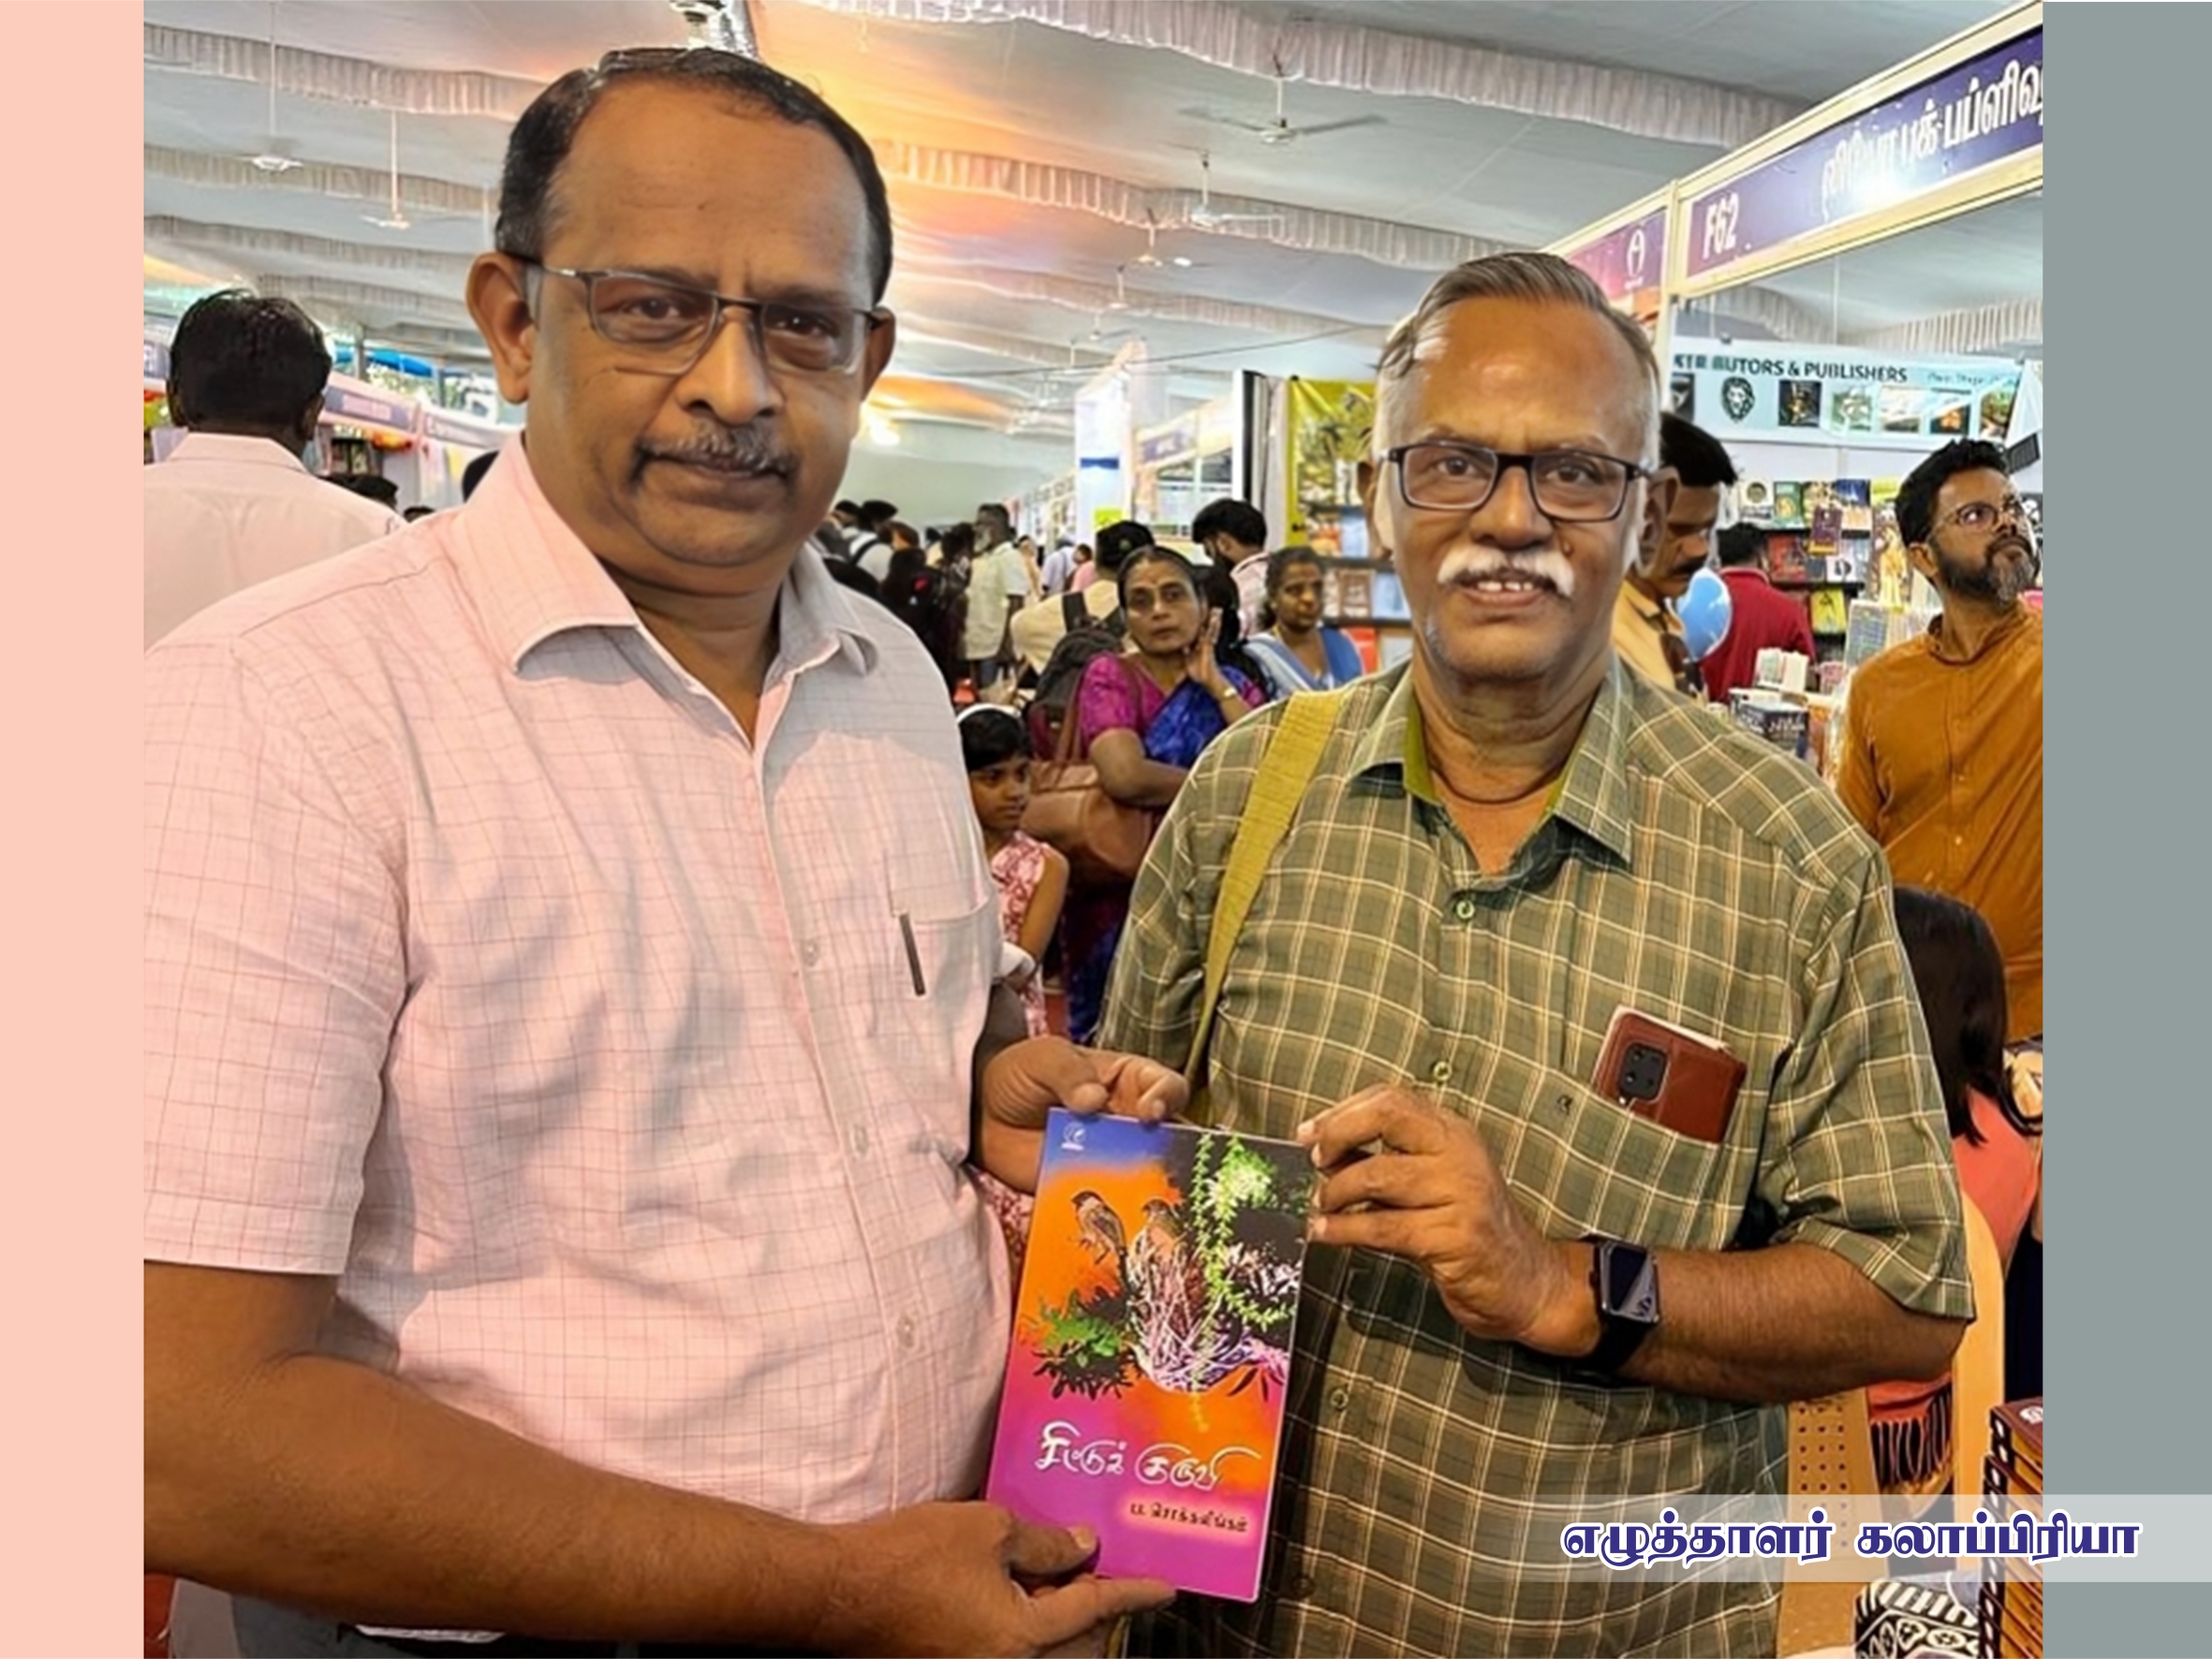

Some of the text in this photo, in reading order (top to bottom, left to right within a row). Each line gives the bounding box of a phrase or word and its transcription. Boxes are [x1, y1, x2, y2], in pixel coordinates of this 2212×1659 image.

[1703, 193, 1739, 259] F62
[1788, 360, 1800, 377] &
[1805, 361, 1908, 383] PUBLISHERS
[1135, 1443, 1262, 1490] குருவி
